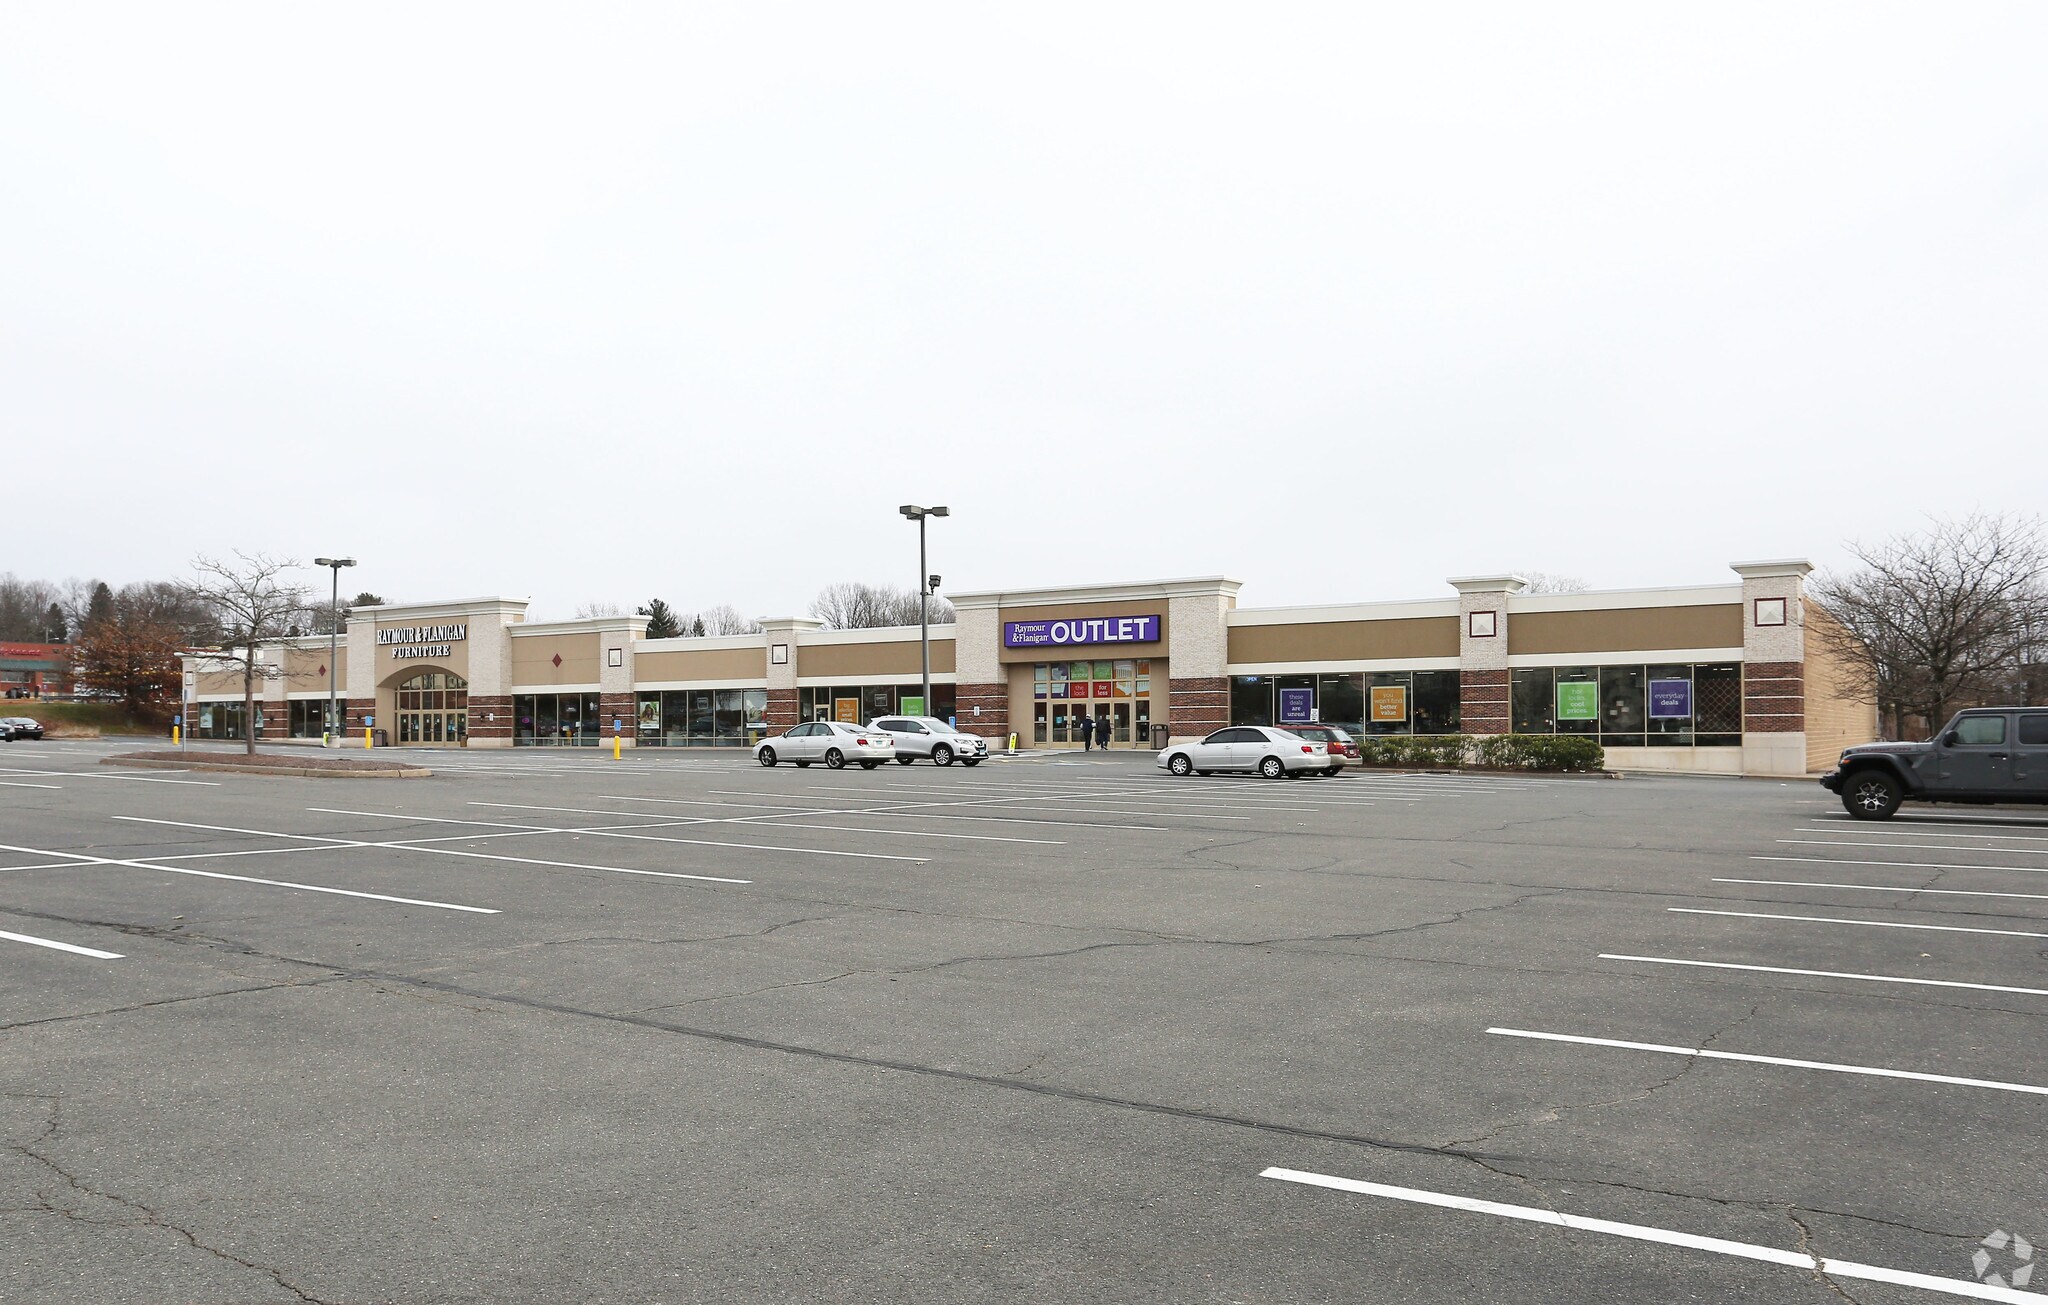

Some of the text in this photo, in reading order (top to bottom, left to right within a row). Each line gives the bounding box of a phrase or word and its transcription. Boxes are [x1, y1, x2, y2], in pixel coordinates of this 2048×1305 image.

[377, 624, 466, 644] RAYMOUR & FLANIGAN
[1014, 623, 1046, 633] Raymour
[1050, 618, 1150, 643] OUTLET
[392, 645, 450, 659] FURNITURE
[1655, 693, 1685, 701] everyday
[1380, 709, 1396, 717] value
